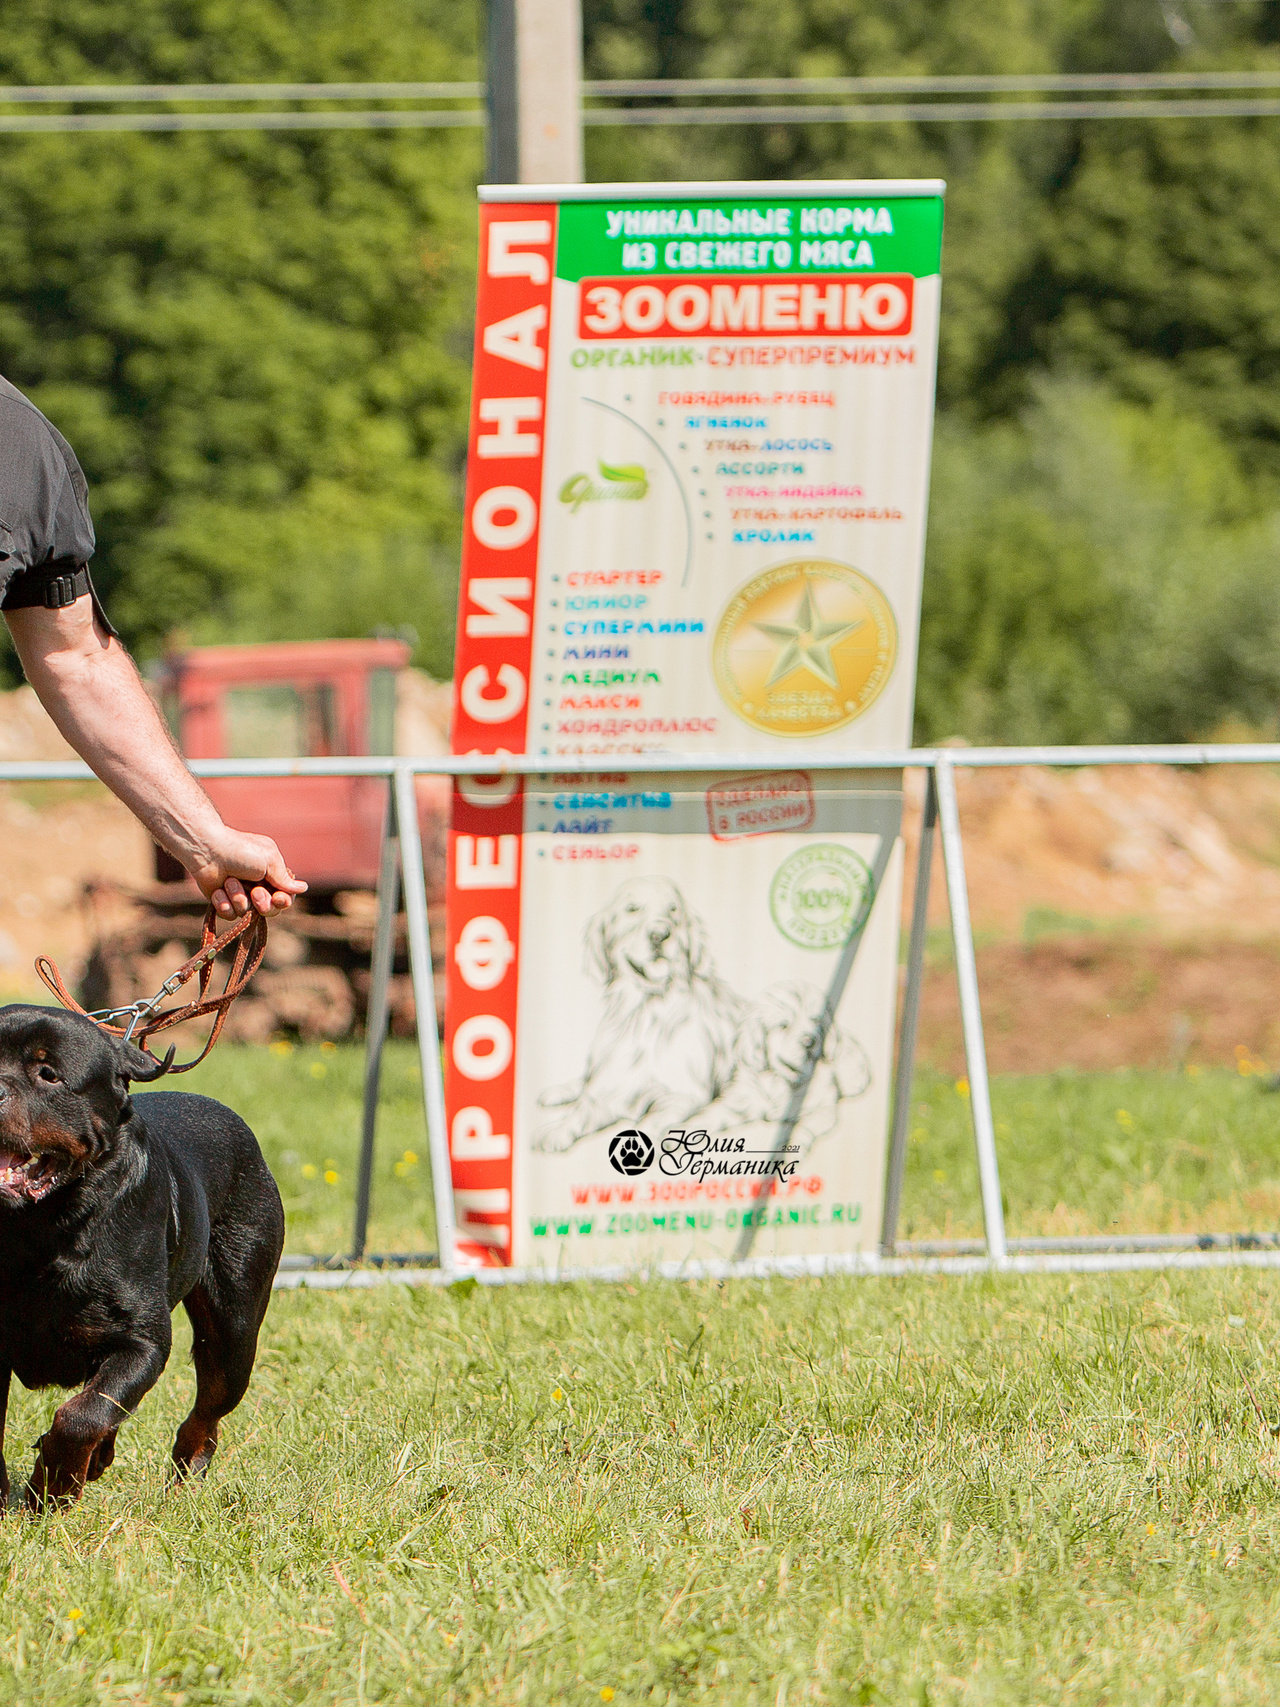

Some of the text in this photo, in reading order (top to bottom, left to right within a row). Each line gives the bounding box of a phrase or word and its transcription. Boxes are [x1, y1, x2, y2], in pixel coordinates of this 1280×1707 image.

[603, 203, 897, 240] УНИКАЛЬНЫЕ КОРМА
[620, 238, 876, 271] ИЗ СВЕЖЕГО МЯСА
[582, 281, 909, 333] ЗООМЕНЮ
[716, 462, 805, 475] АССОРТИ
[732, 529, 815, 544] КРОЛИК
[566, 570, 663, 587] СТАРТЕР
[564, 594, 648, 611] ЮНИОР
[563, 618, 705, 636] СУПЕРМИНИ
[562, 644, 630, 660] МИНИ
[560, 668, 661, 687] МЕДИУМ
[559, 694, 642, 710] МАКСИ
[452, 217, 553, 1250] ПРОФЕССИОНАЛ
[557, 717, 718, 736] ХОНДРОПЛЮС
[552, 815, 613, 834] ЛАЙТ
[552, 845, 639, 862] СЕНЬОР
